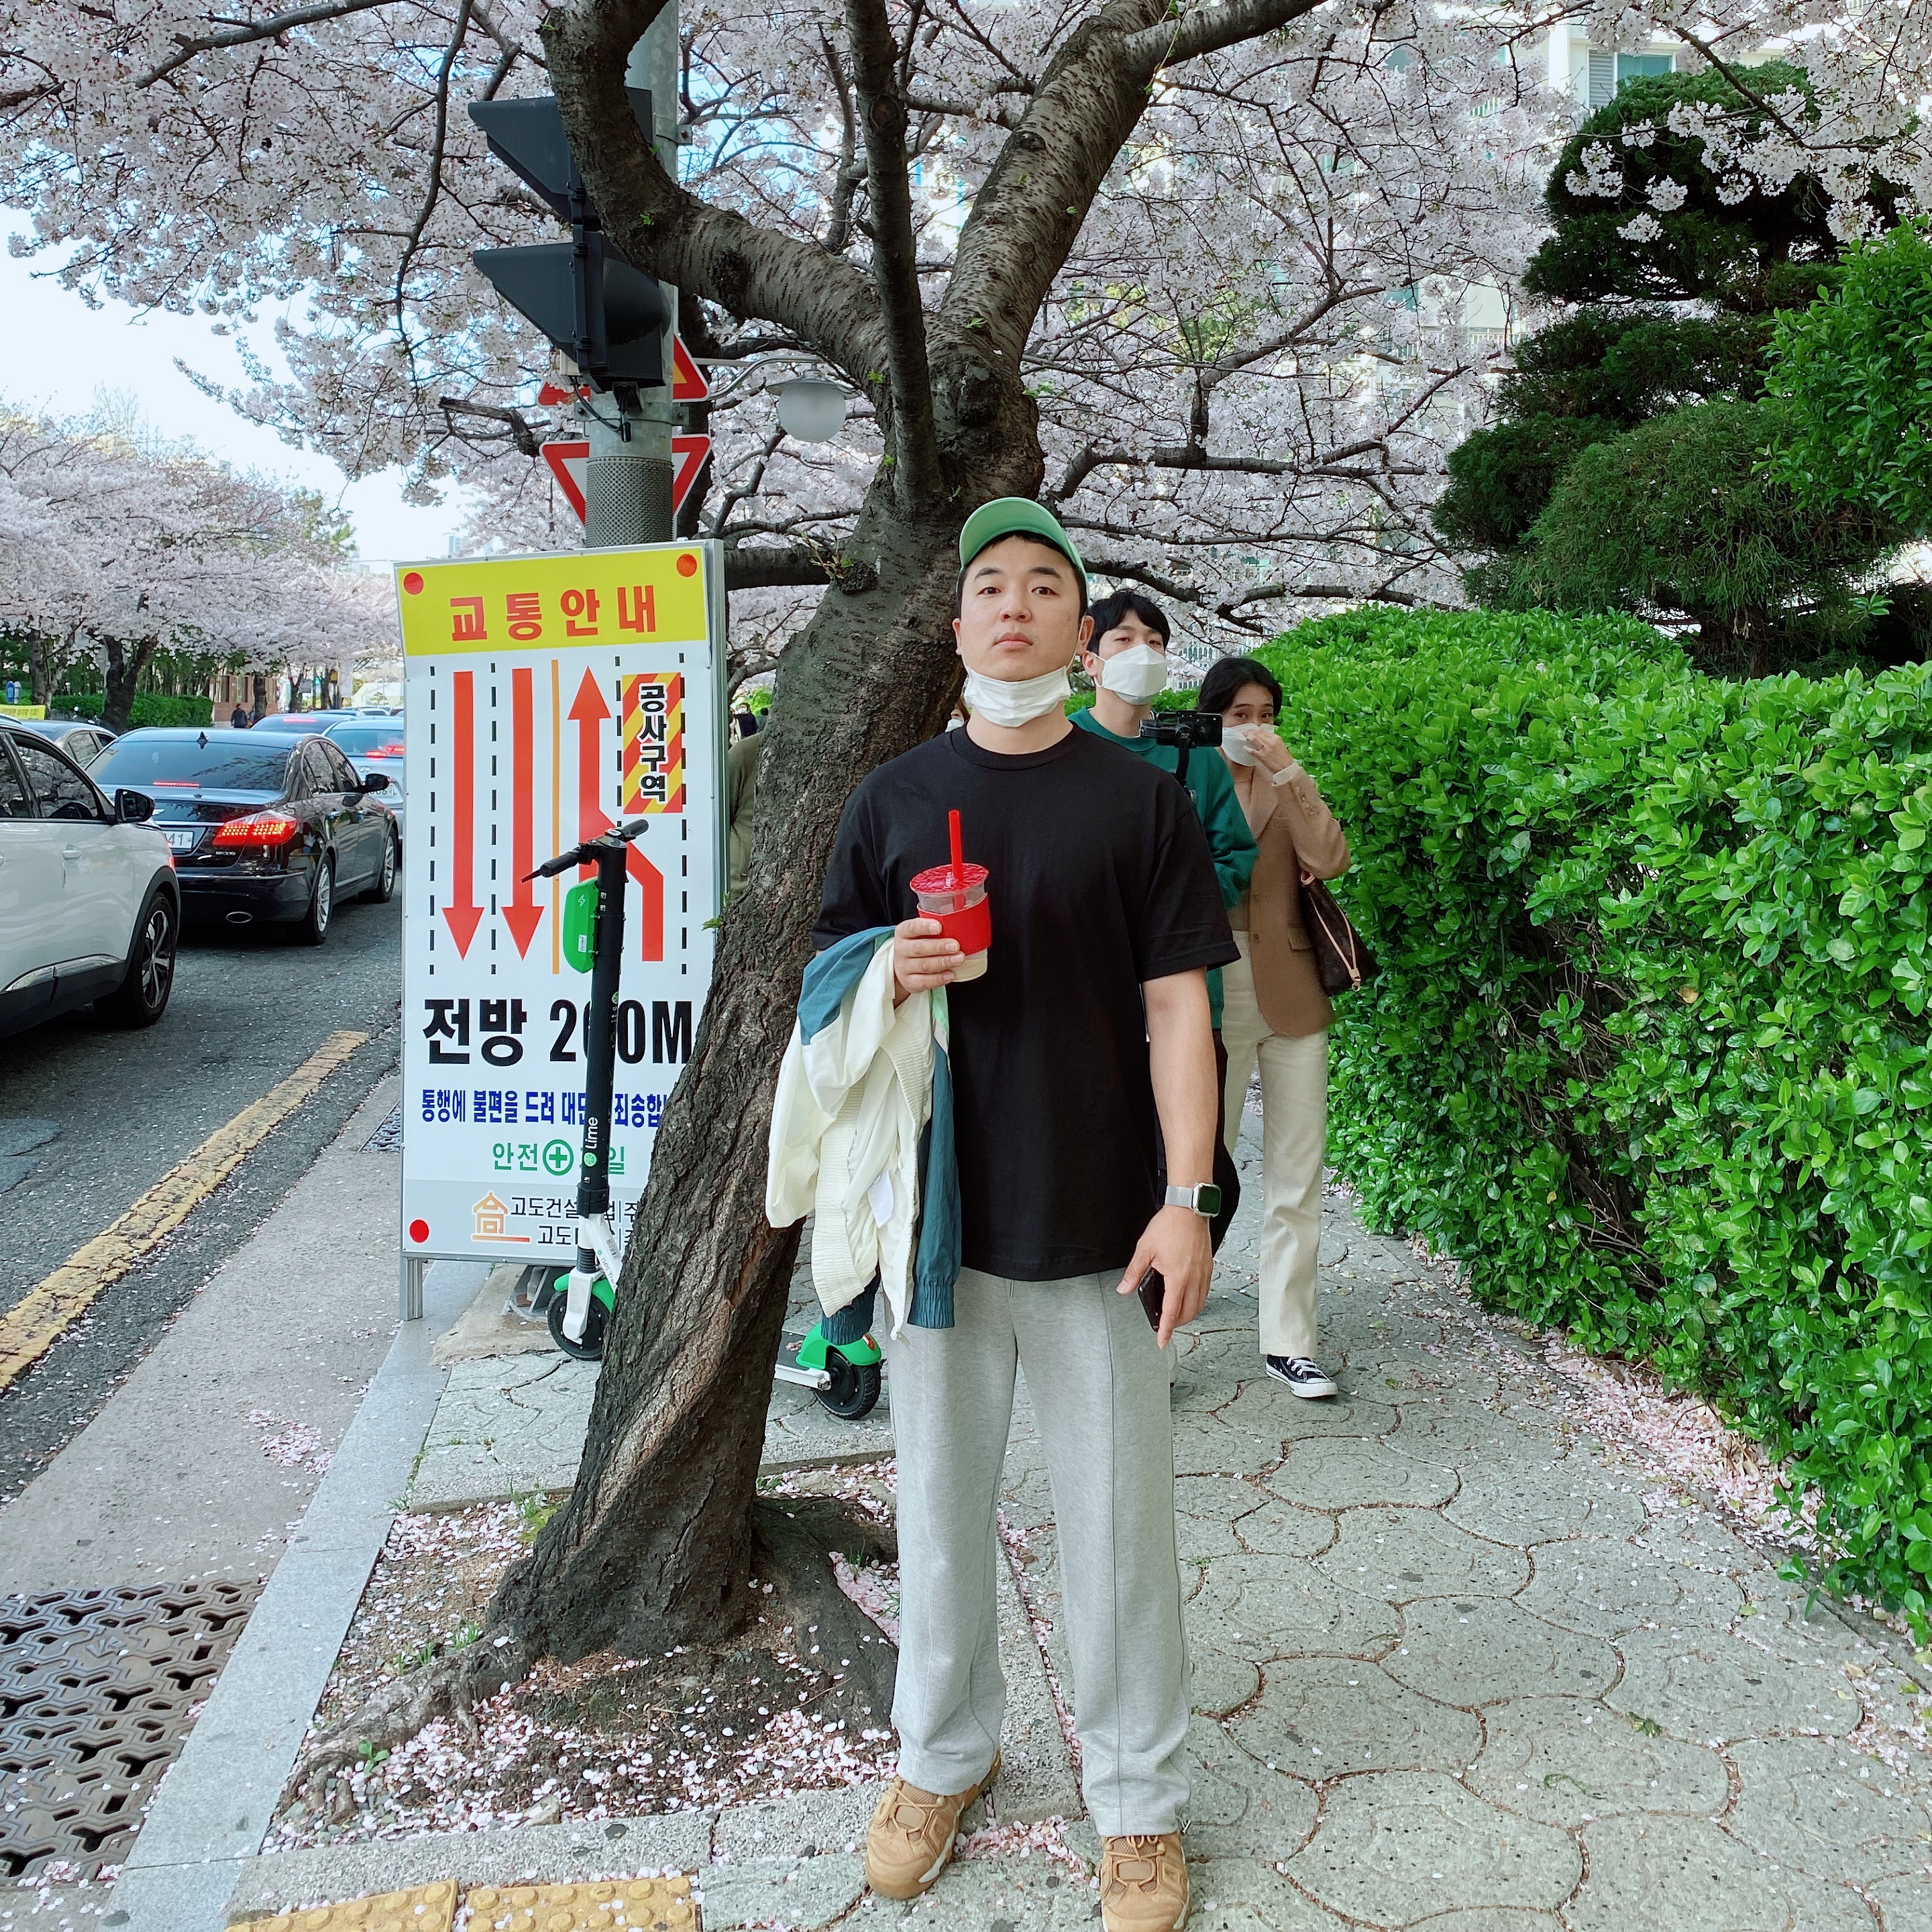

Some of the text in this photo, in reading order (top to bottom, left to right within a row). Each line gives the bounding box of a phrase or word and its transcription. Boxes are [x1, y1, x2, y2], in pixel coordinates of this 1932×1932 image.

[449, 585, 655, 641] 교통안내
[639, 685, 667, 802] 공사구역
[423, 998, 693, 1067] 전방 20M
[422, 1089, 466, 1123] 통행에
[473, 1090, 518, 1124] 불편을
[525, 1091, 554, 1124] 드려
[614, 1093, 667, 1128] 죄송합
[492, 1142, 538, 1171] 안전
[585, 1116, 598, 1150] Lime
